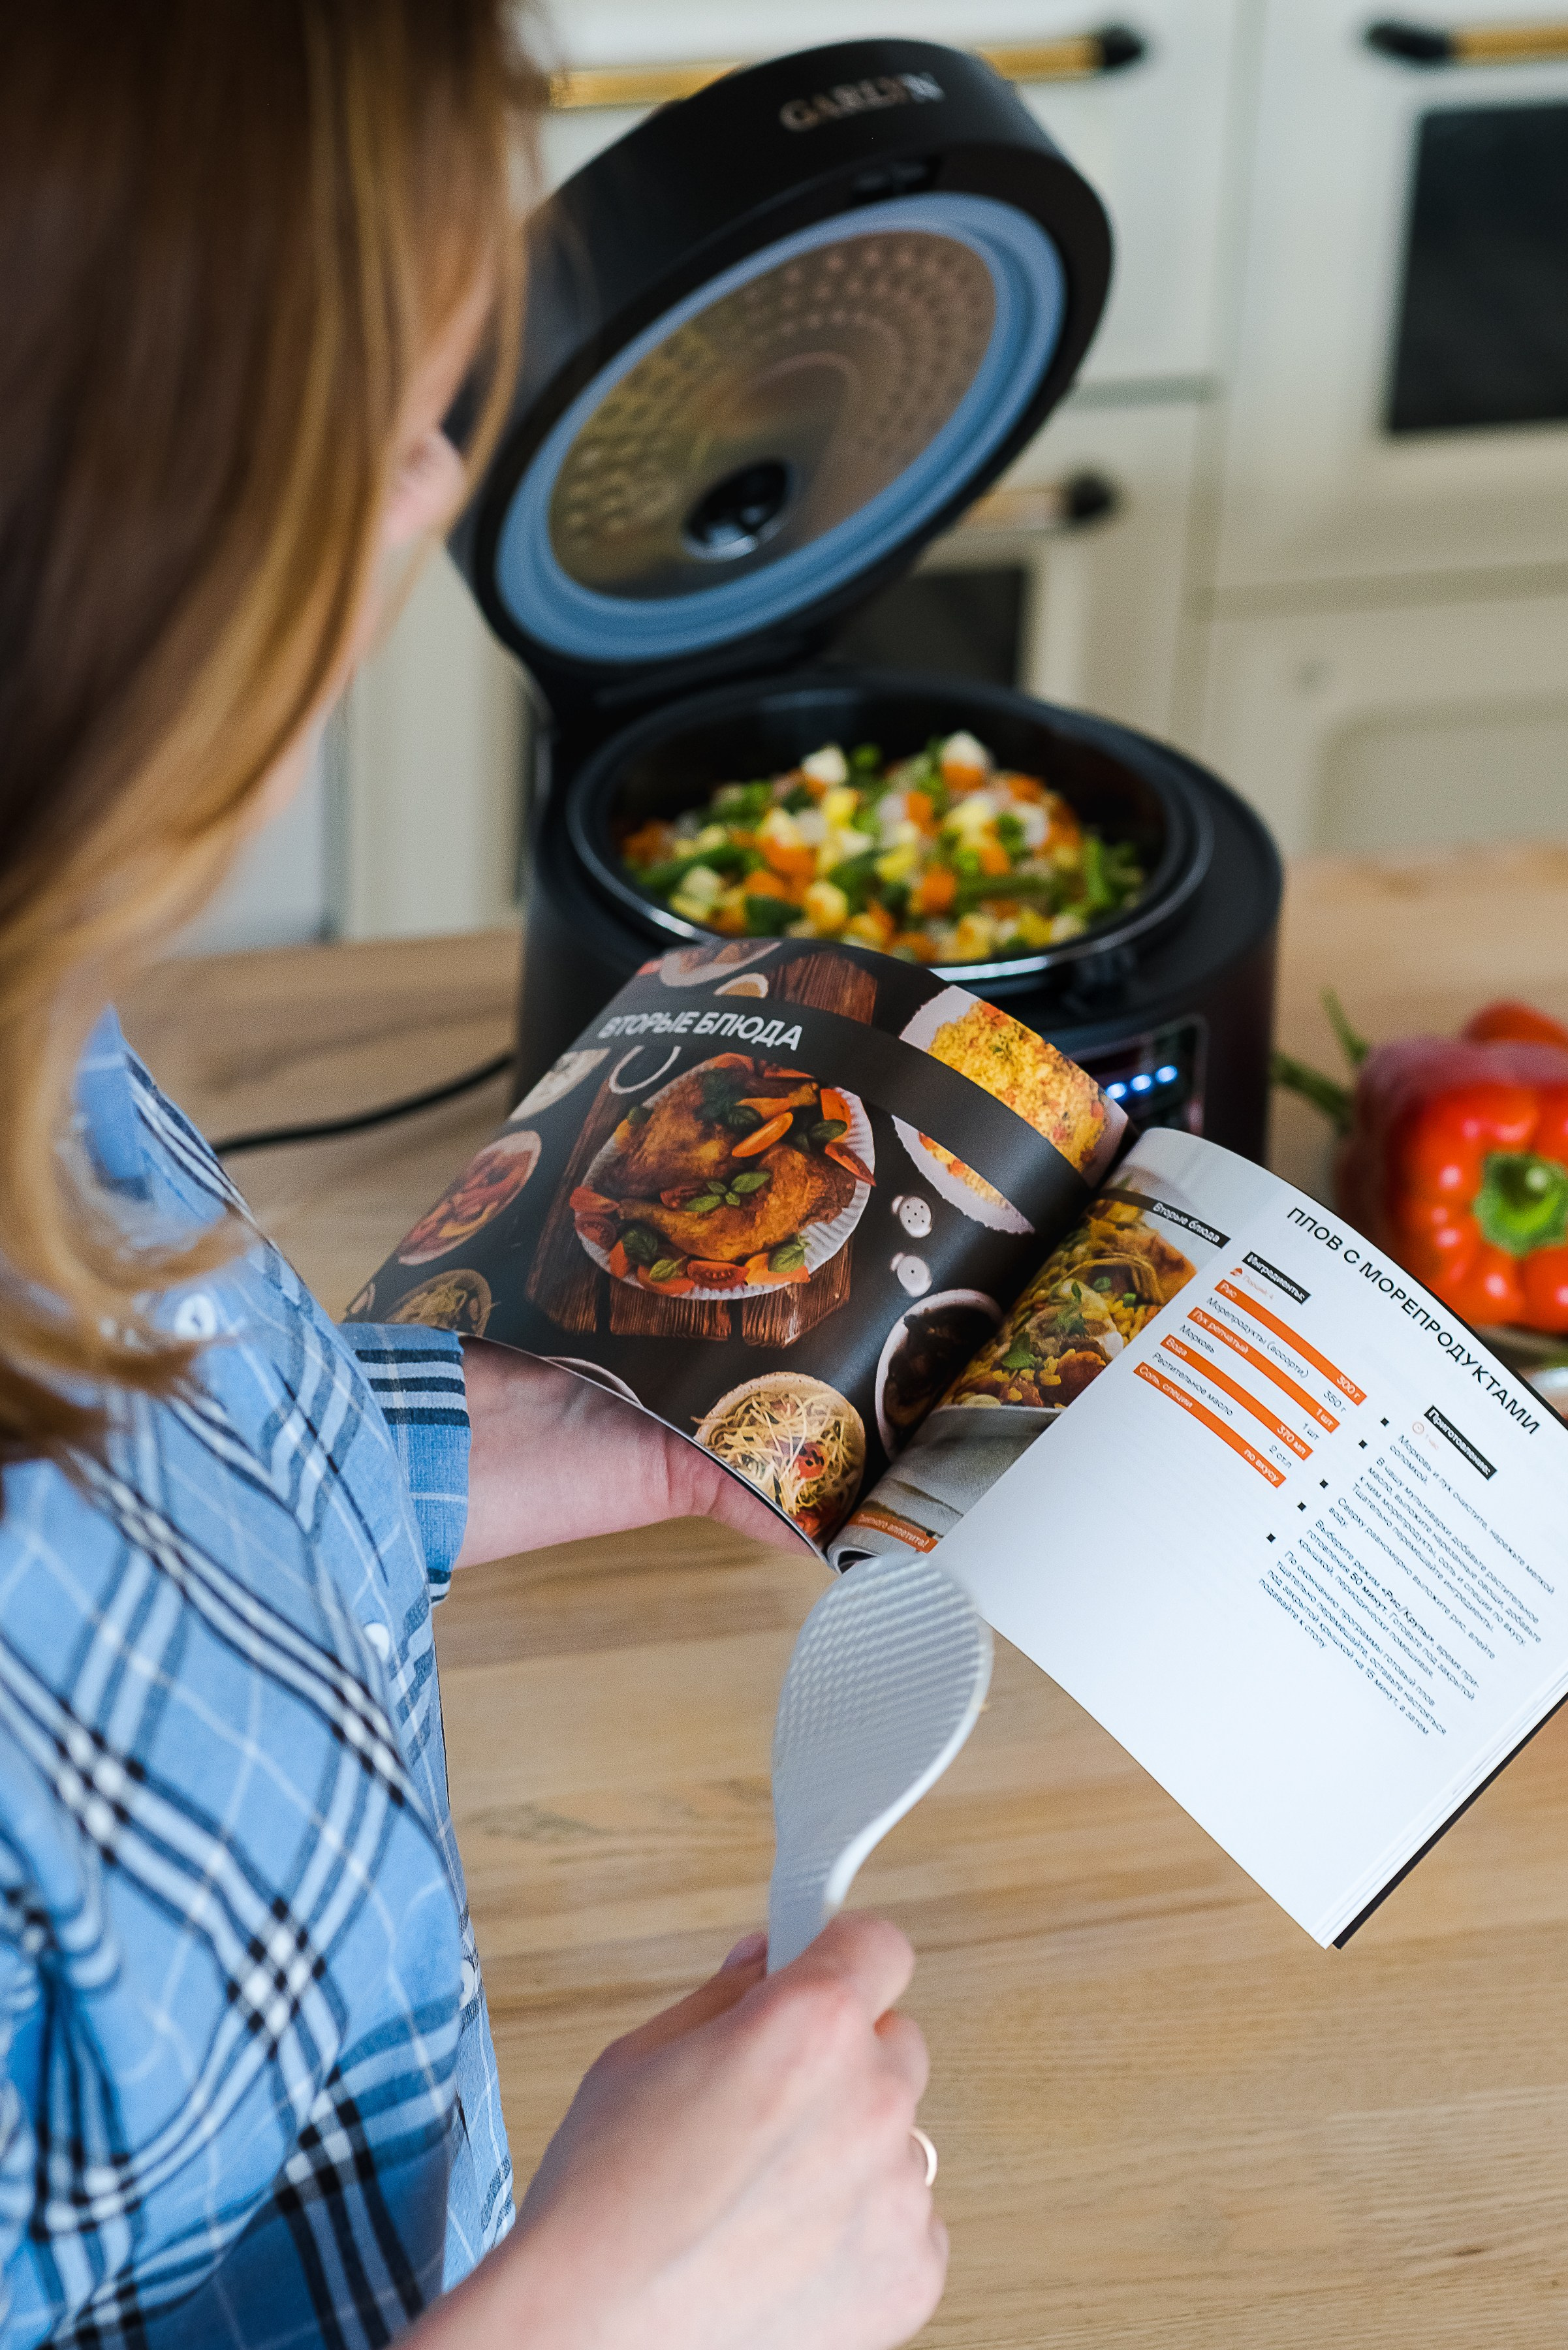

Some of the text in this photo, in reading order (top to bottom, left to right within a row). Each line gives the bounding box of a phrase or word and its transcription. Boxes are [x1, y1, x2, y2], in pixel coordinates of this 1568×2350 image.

[597, 1011, 803, 1051] ВТОРЫЕ БЛЮДА
[1152, 1202, 1220, 1243] Вторые блюда
[1179, 1324, 1215, 1354] Морковь
[1306, 1429, 1320, 1441] шт
[1193, 1309, 1209, 1325] Лук
[1320, 1413, 1334, 1427] шт
[1206, 1296, 1267, 1345] Морепродукты
[1266, 1341, 1309, 1379] (ассорти)
[1323, 1389, 1342, 1408] 350
[1286, 1206, 1541, 1435] ПЛОВ С МОРЕПРОДУКТАМИ
[1336, 1375, 1359, 1395] 300
[1152, 1351, 1207, 1395] Растительное
[1206, 1393, 1233, 1417] масло
[1268, 1445, 1278, 1454] 2
[1162, 1383, 1193, 1409] специи
[1244, 1449, 1256, 1462] по
[1251, 1459, 1279, 1482] вкусу
[1165, 1337, 1306, 1455] Вода 370 мл
[1428, 1410, 1492, 1476] Приготовление:
[1328, 1507, 1349, 1529] воду.
[1389, 1445, 1428, 1484] соломкой.
[1398, 1434, 1432, 1472] Морковь
[1439, 1478, 1452, 1493] лук
[1452, 1492, 1488, 1531] очистите,
[1489, 1529, 1526, 1566] нарежьте
[1525, 1565, 1555, 1595] мелкой
[1315, 1519, 1479, 1689] Выберите режим «Рис/Крупы», время при-
[1338, 1497, 1496, 1659] Сверху равномерно выложите рис, влейте
[1352, 1482, 1494, 1633] Тщательно перемешайте ингредиенты.
[1365, 1482, 1382, 1499] ним
[1381, 1497, 1437, 1558] морепродукты,
[1438, 1556, 1456, 1577] соль
[1464, 1582, 1493, 1613] специи
[1492, 1611, 1503, 1623] по
[1503, 1622, 1526, 1647] вкусу.
[1368, 1467, 1541, 1644] масло, выложите нарезанные овощи, добавьте
[1376, 1457, 1539, 1624] В чашу мультиварки добавьте растительное
[1259, 1578, 1299, 1620] подавайте
[1304, 1625, 1327, 1649] столу
[1267, 1569, 1429, 1736] под закрытой крышкой на 15 минут, а затем
[1276, 1560, 1447, 1736] тщательно перемешайте, оставьте настояться
[1284, 1550, 1435, 1707] По окончанию программы готовый плов
[1298, 1538, 1434, 1680] крышкой, периодически помешивая.
[1306, 1529, 1475, 1702] готовления 50 минут. Готовьте под закрытой
